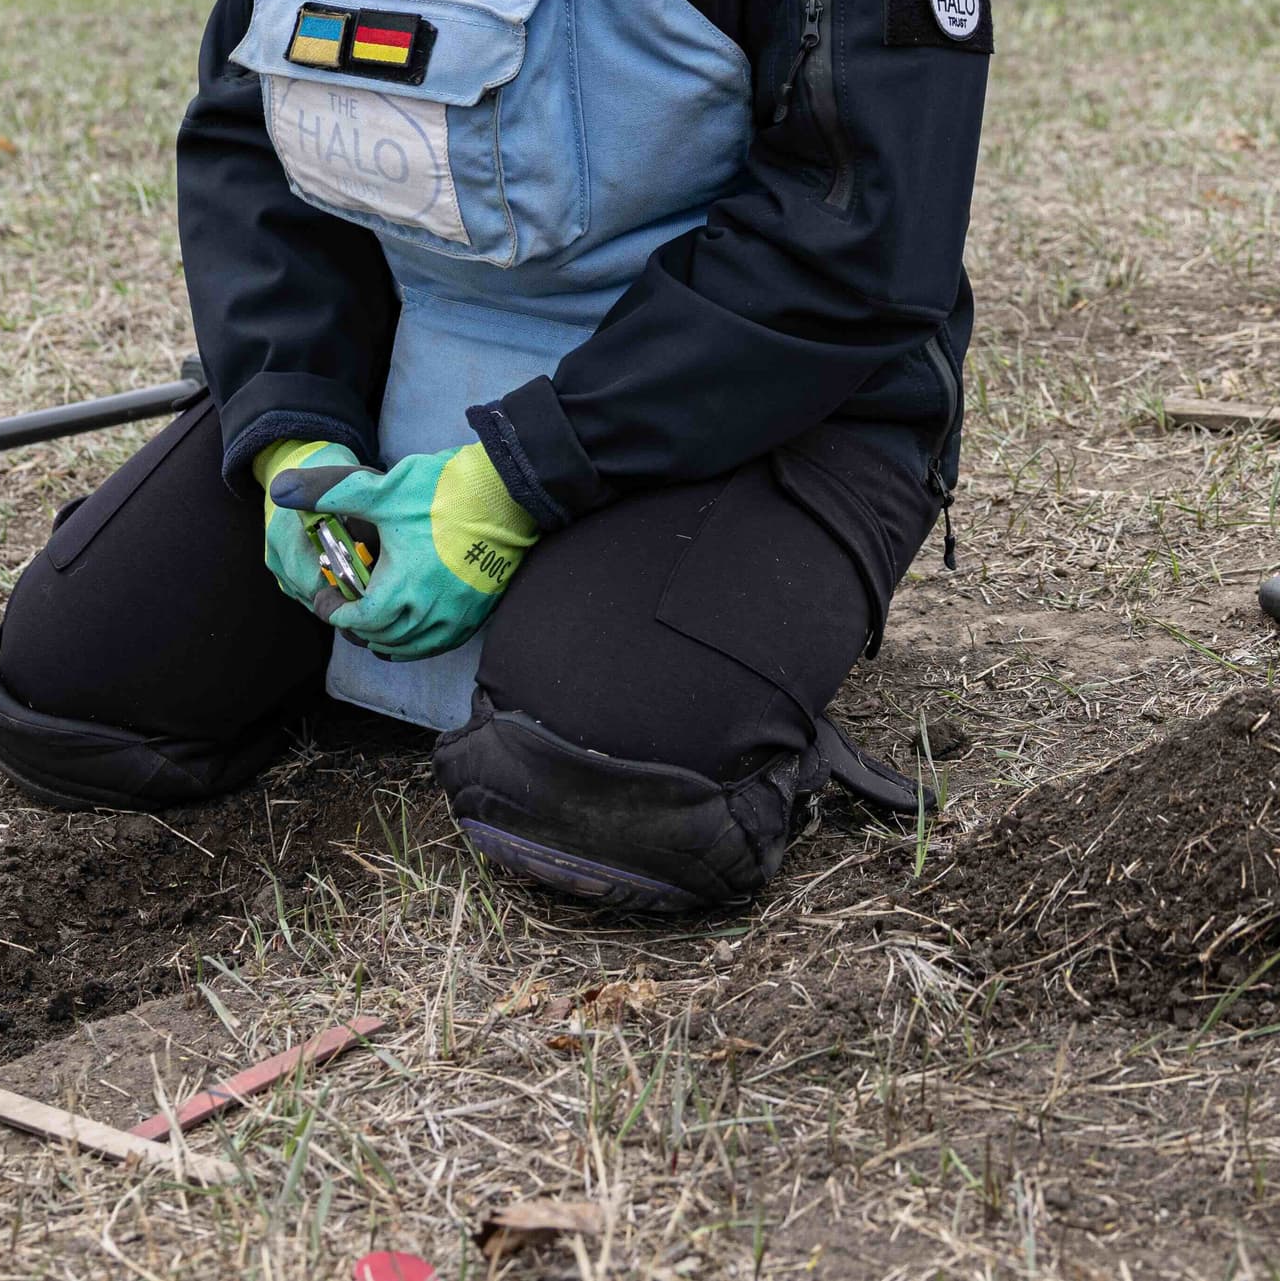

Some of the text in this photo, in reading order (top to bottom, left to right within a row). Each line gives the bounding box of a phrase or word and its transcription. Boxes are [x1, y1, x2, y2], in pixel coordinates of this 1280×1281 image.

[948, 16, 967, 29] TRUST
[328, 92, 359, 120] THE
[298, 109, 409, 185] HALO
